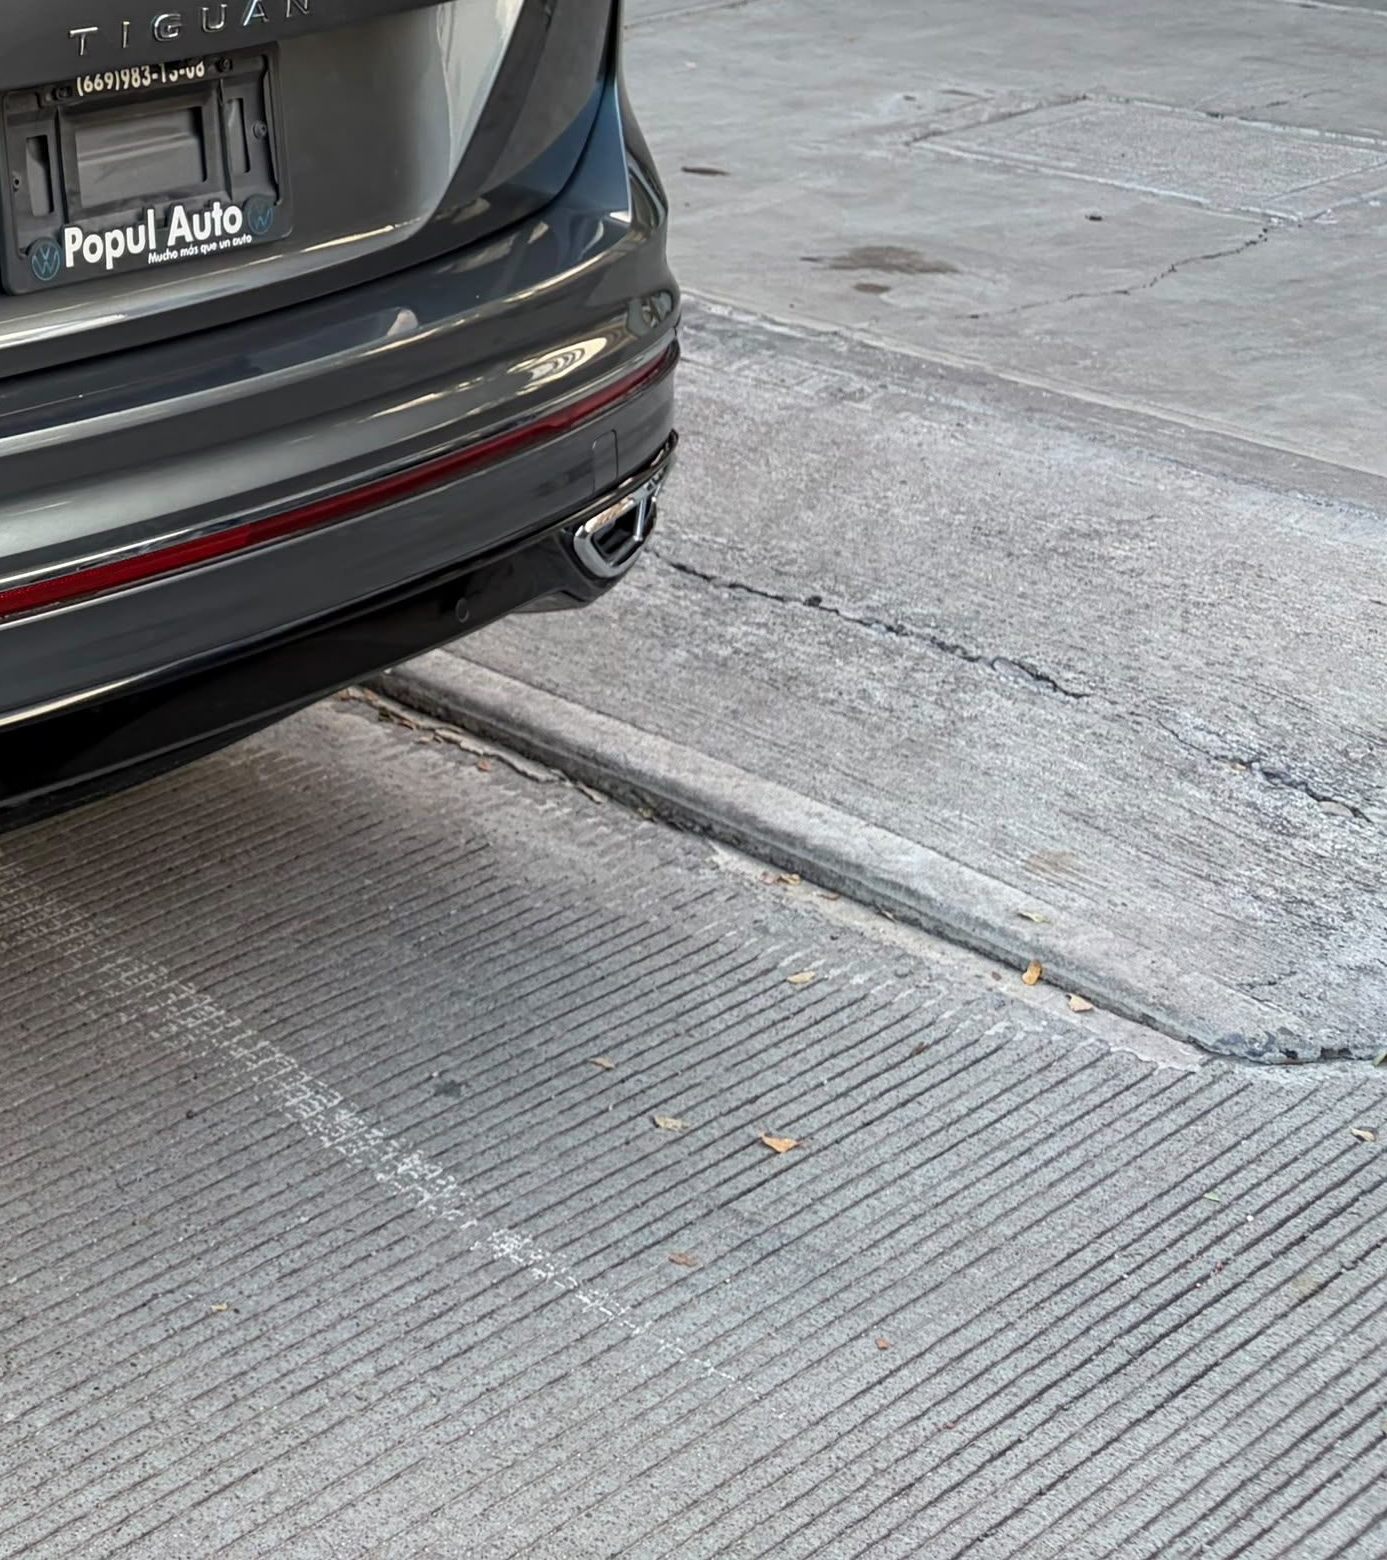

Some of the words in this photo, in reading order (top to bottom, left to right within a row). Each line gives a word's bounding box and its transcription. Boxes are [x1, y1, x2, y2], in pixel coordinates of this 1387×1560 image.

[64, 208, 157, 271] Popul
[167, 201, 243, 246] Auto
[148, 249, 178, 264] Mucho
[180, 244, 199, 259] más
[200, 243, 217, 254] que
[219, 239, 231, 249] un
[232, 233, 253, 245] auto
